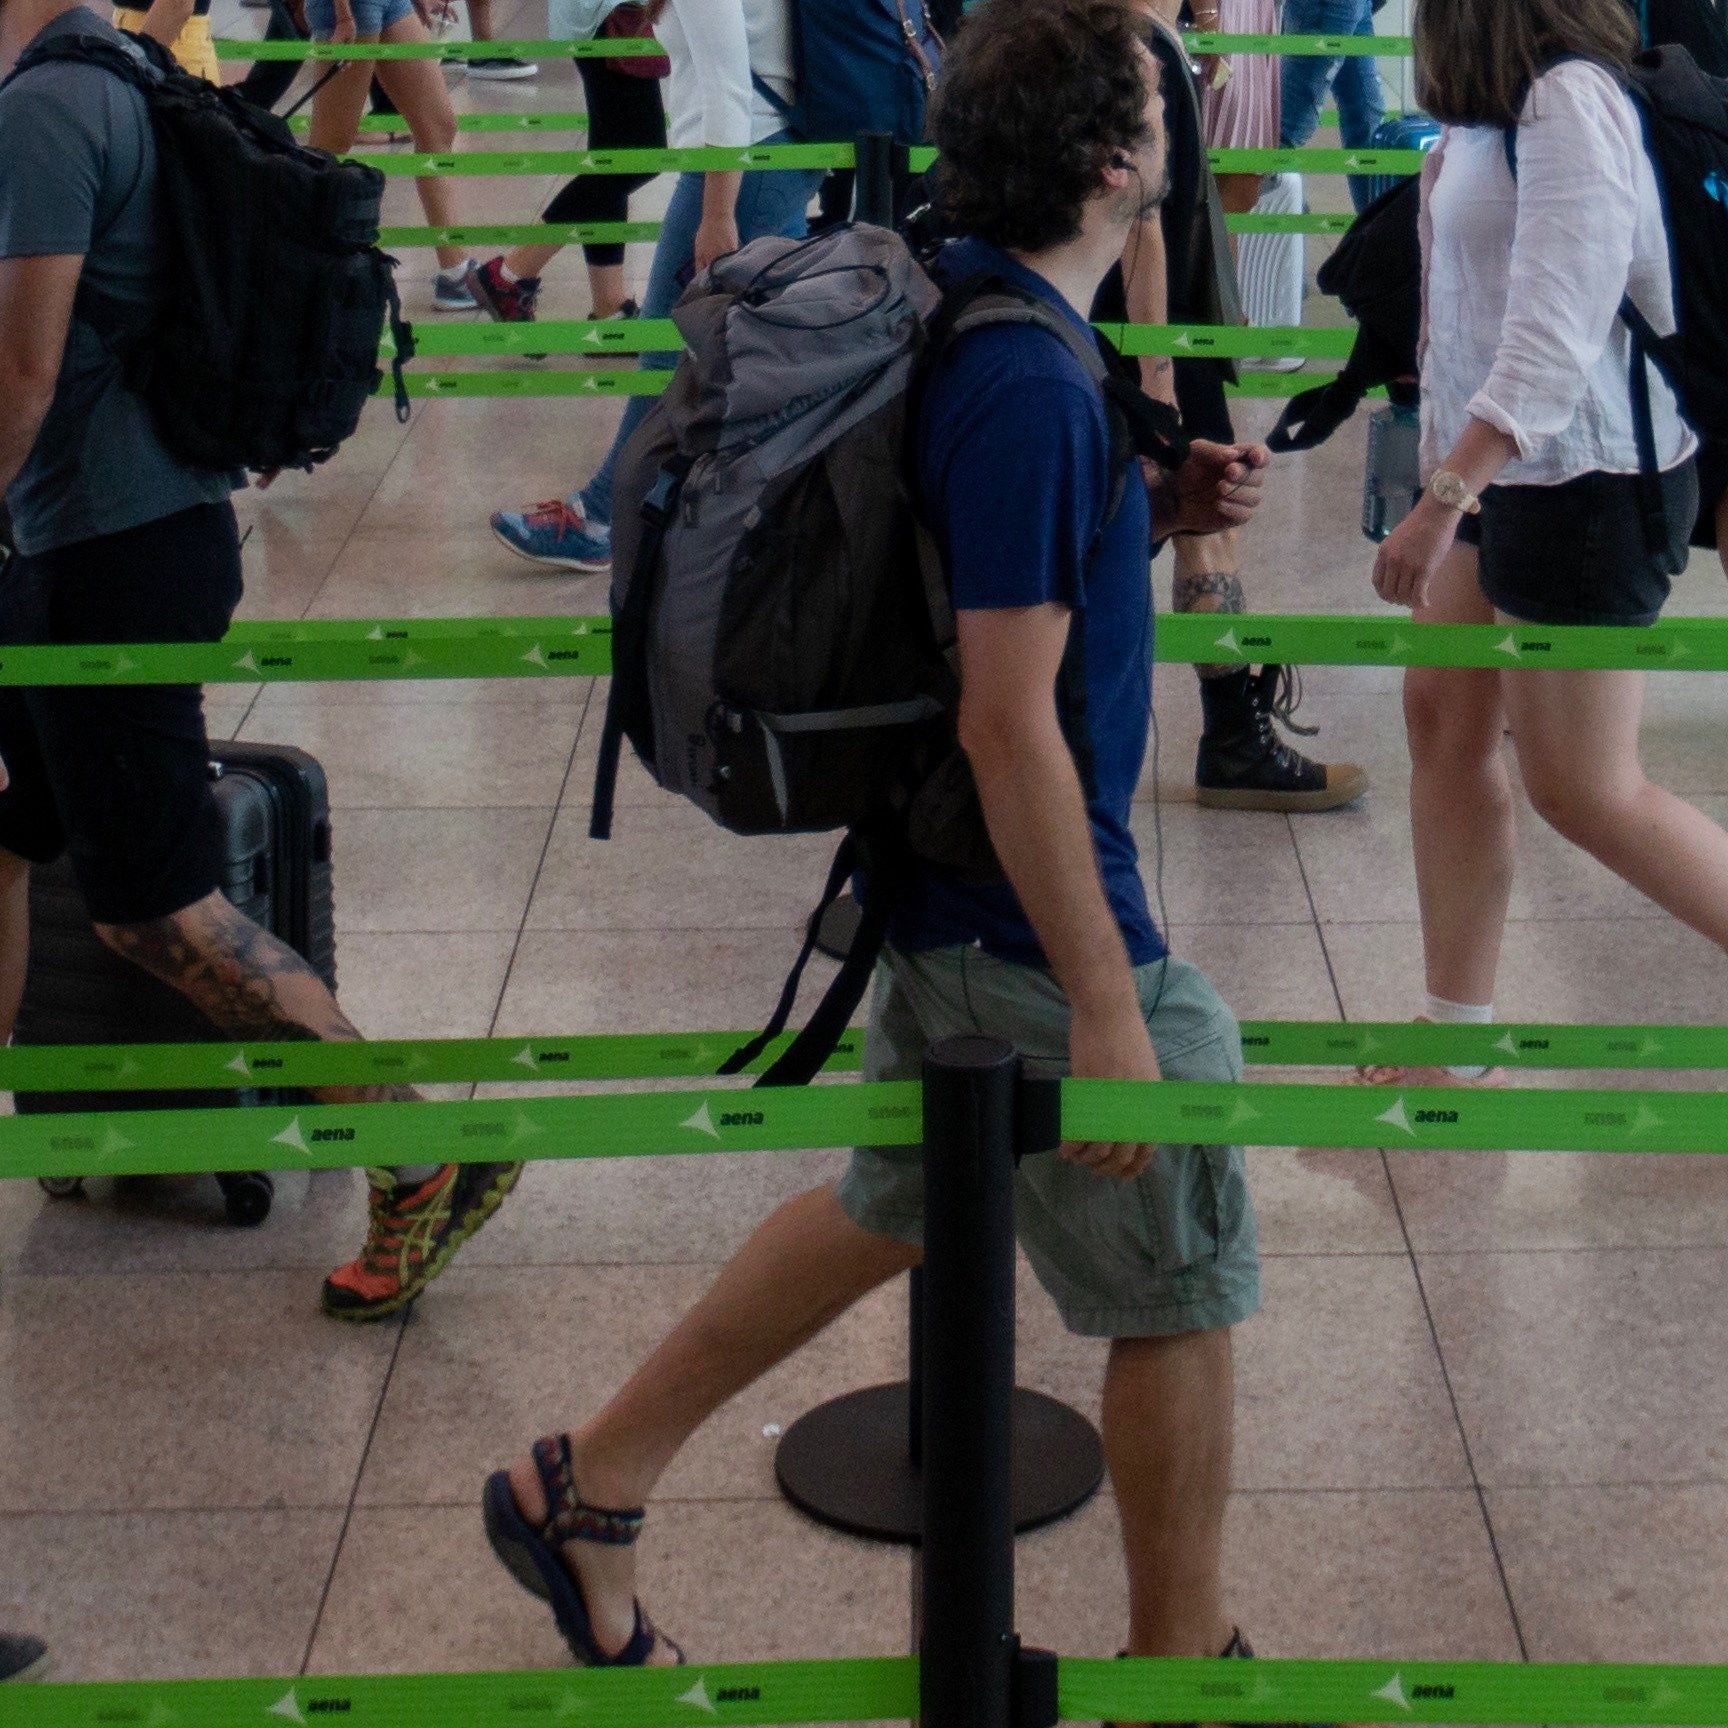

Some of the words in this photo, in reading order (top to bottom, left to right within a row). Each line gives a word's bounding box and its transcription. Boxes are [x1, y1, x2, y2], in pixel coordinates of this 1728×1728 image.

[720, 1112, 764, 1126] aena
[1414, 1109, 1459, 1123] aena
[310, 1128, 356, 1142] aena
[716, 1687, 761, 1702] aena
[1411, 1685, 1455, 1699] aena
[307, 1699, 352, 1713] aena
